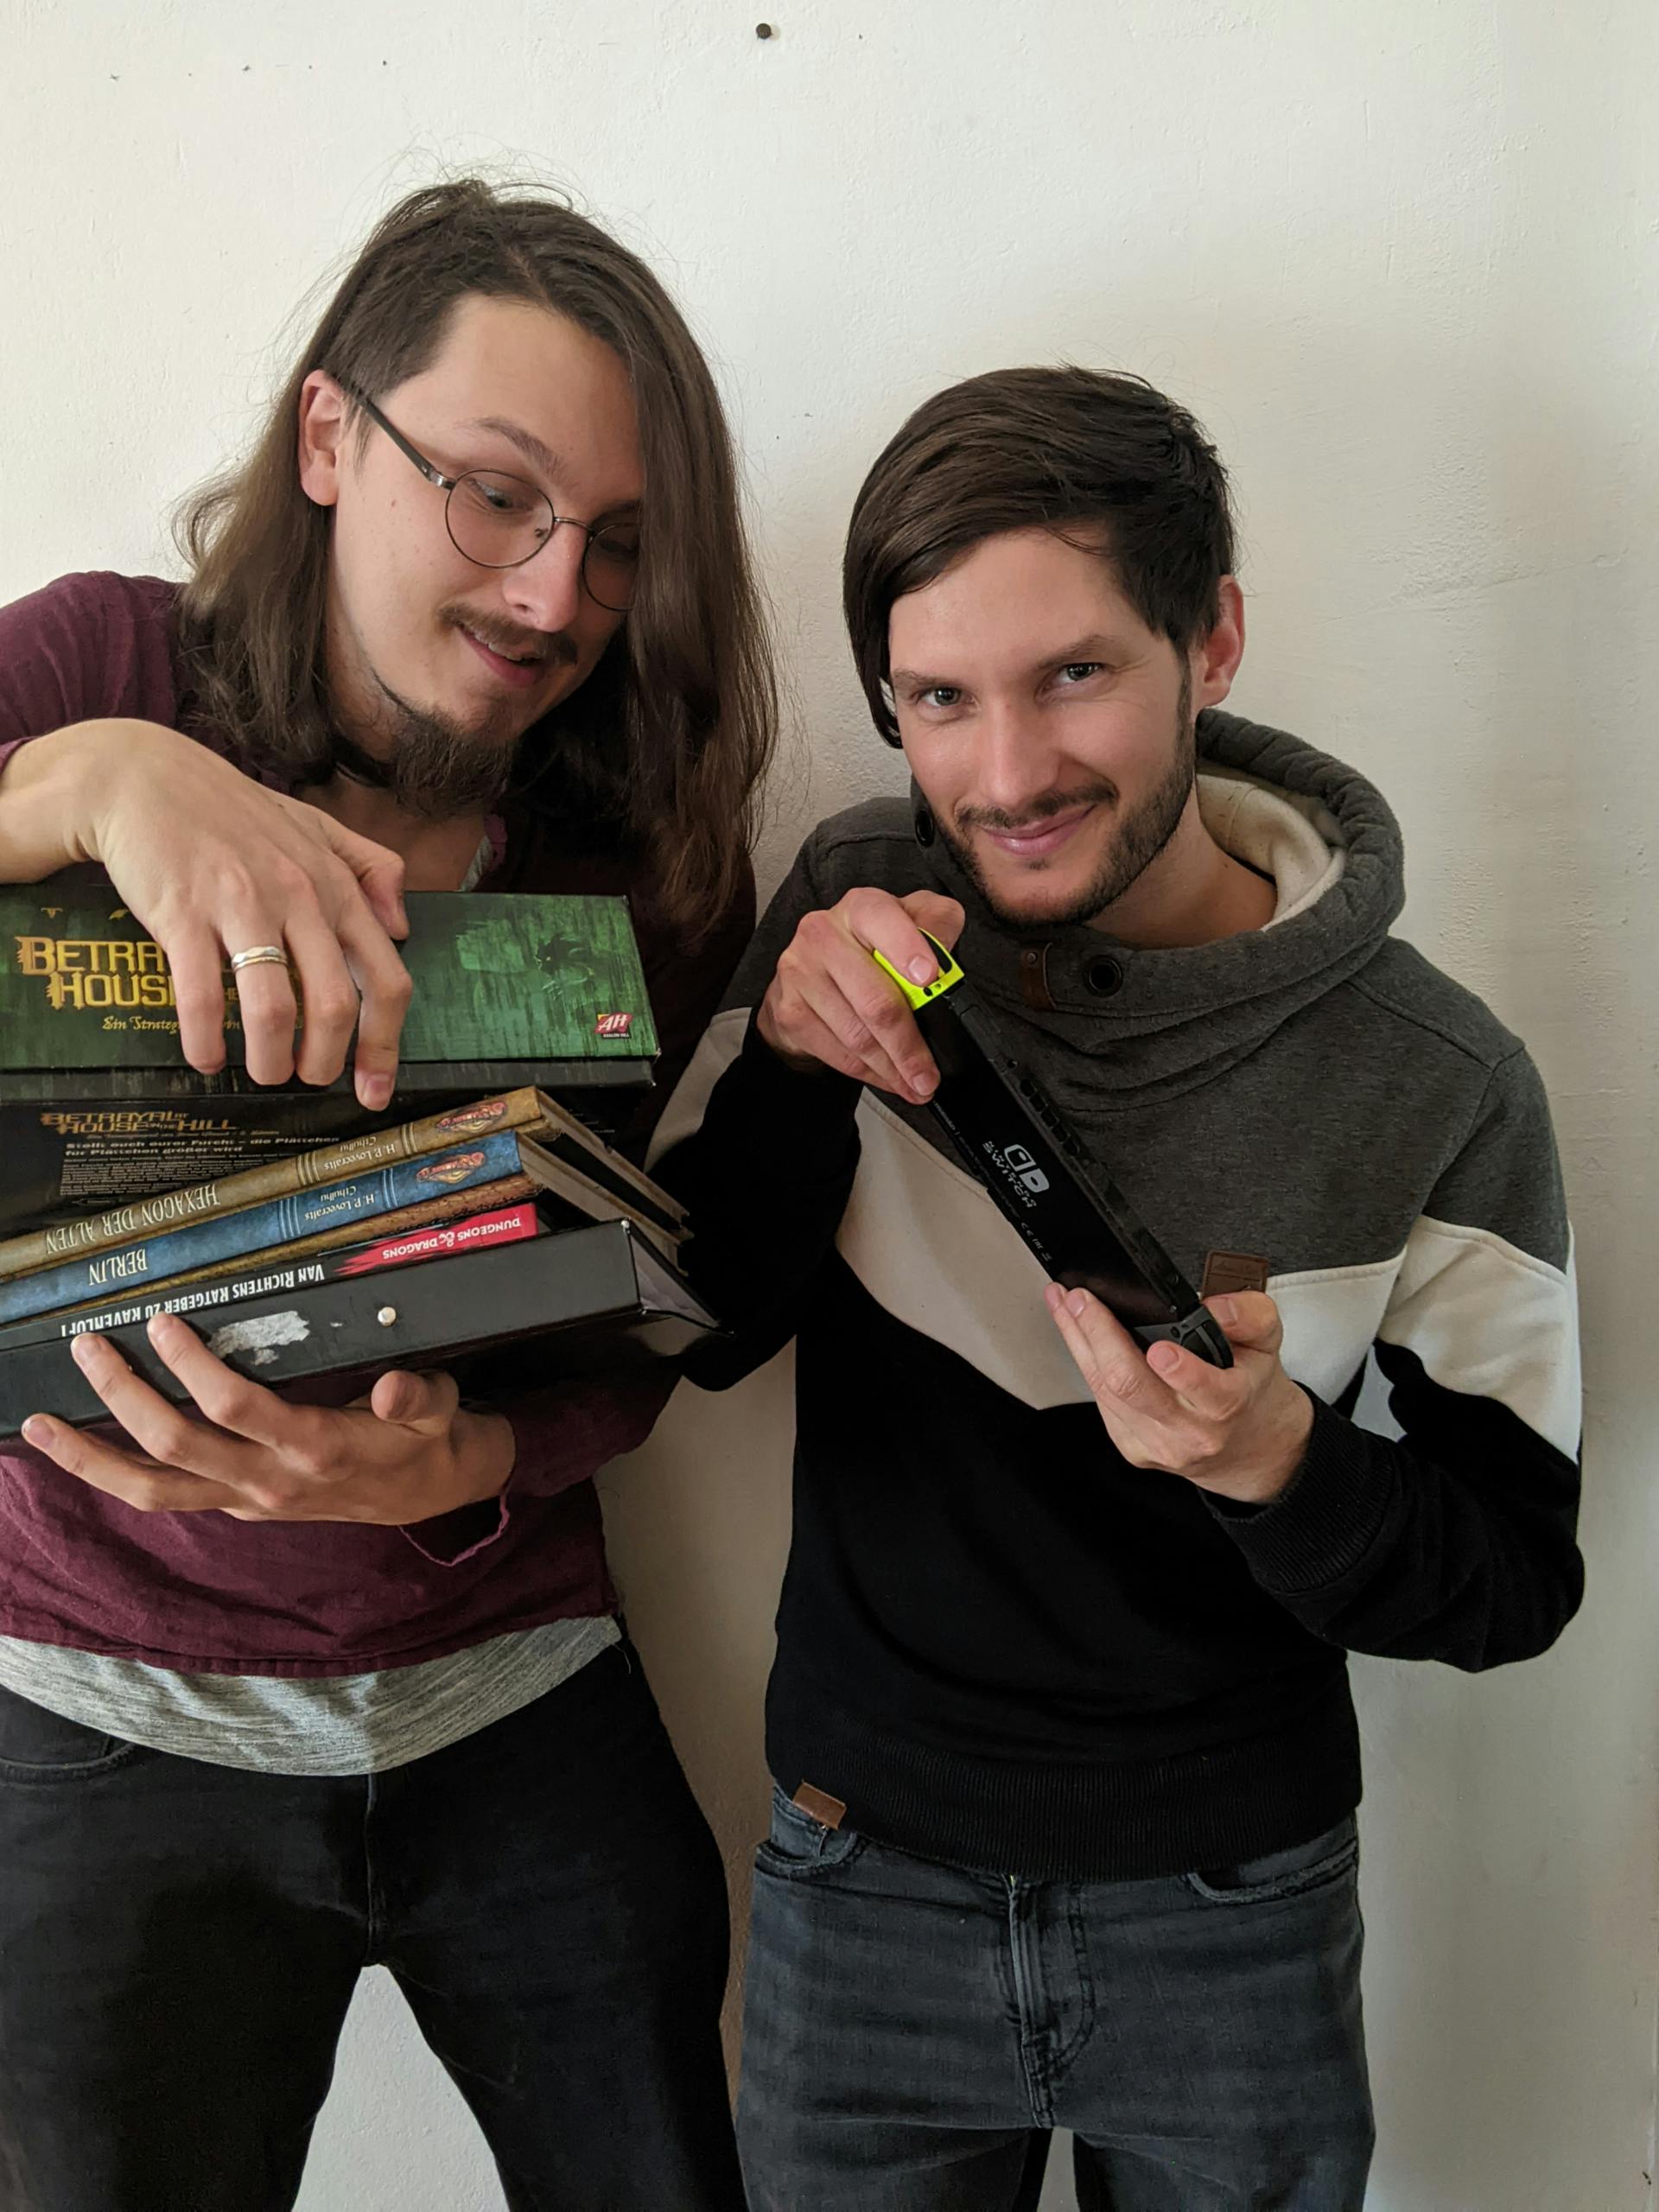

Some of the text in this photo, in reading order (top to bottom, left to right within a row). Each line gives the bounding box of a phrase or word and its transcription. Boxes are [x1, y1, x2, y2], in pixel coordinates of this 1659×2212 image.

[15, 936, 165, 975] BETRA
[102, 1015, 128, 1030] Ein
[597, 1014, 628, 1032] AH
[41, 1110, 178, 1127] BETRAYAL
[55, 1122, 148, 1135] HOUSE
[177, 1118, 239, 1132] HILL
[340, 1136, 377, 1152] Cthulhu
[982, 1141, 1033, 1208] SWITCH
[988, 1141, 1037, 1206] NINTENDO
[321, 1185, 357, 1202] Cthulhu
[101, 1208, 137, 1236] DER
[45, 1221, 96, 1254] ALTEN
[383, 1217, 521, 1259] DUNGEONS & DRAGONS
[89, 1249, 148, 1286] BERLIN
